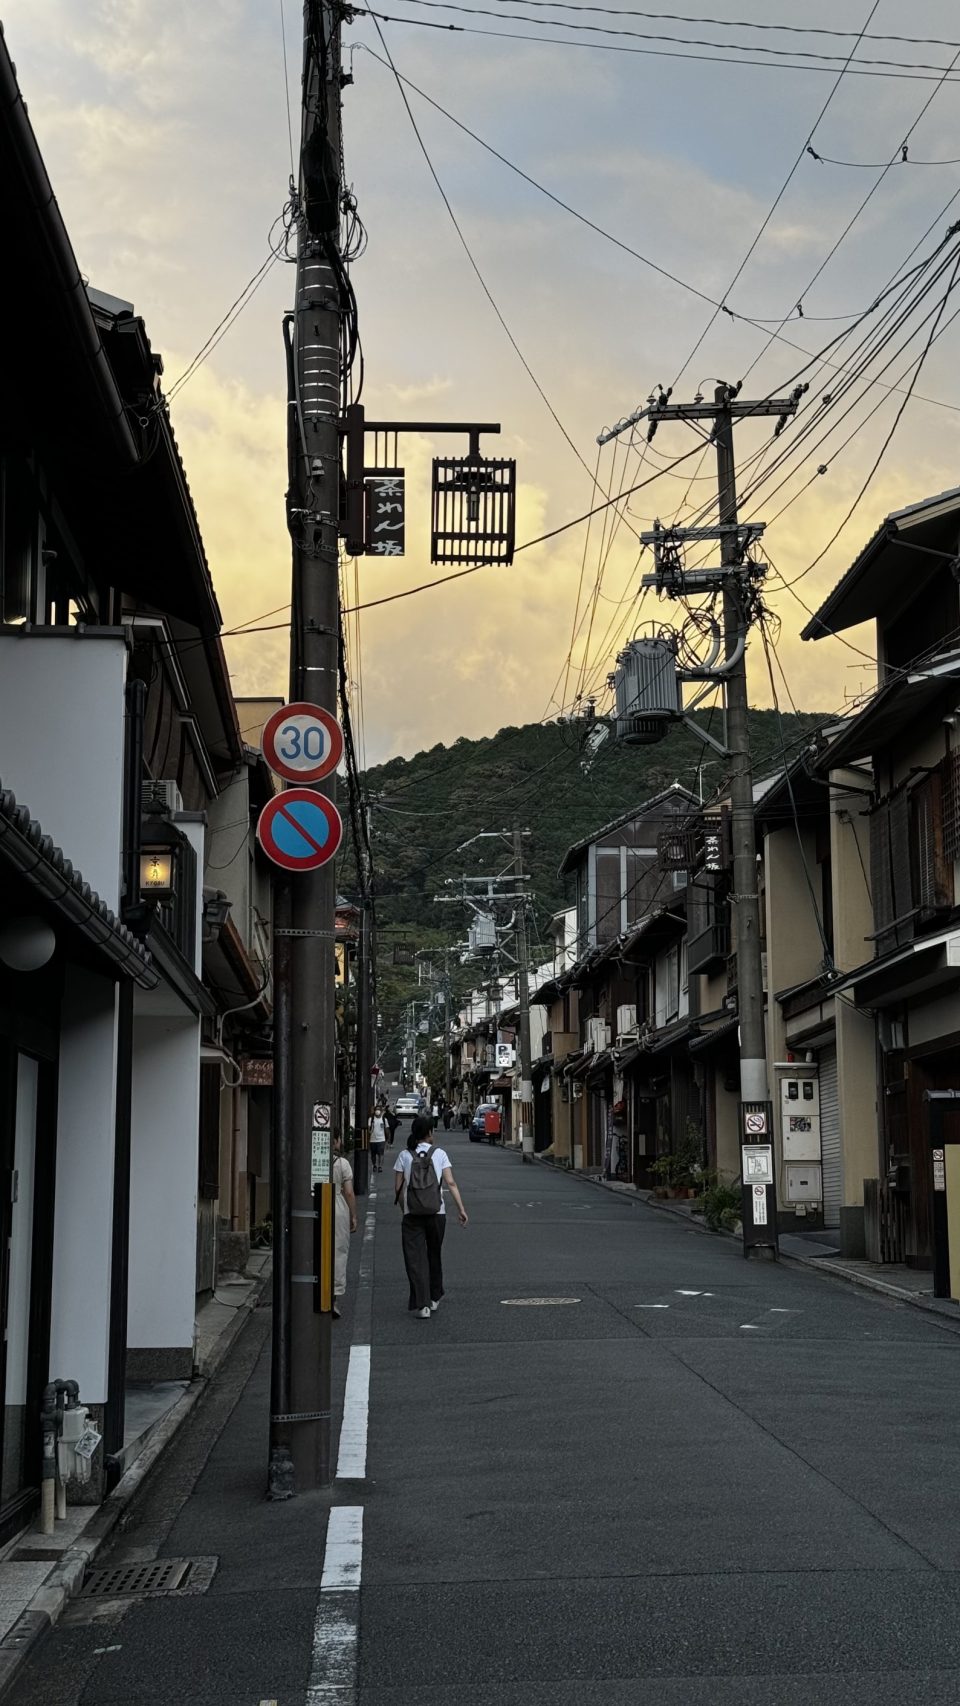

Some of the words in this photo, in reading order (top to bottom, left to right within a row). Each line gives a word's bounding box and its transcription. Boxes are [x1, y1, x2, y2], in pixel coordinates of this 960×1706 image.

[372, 479, 404, 556] 茶わん坂
[281, 726, 324, 760] 30
[705, 836, 720, 870] 茶わん坂
[498, 1045, 508, 1055] P
